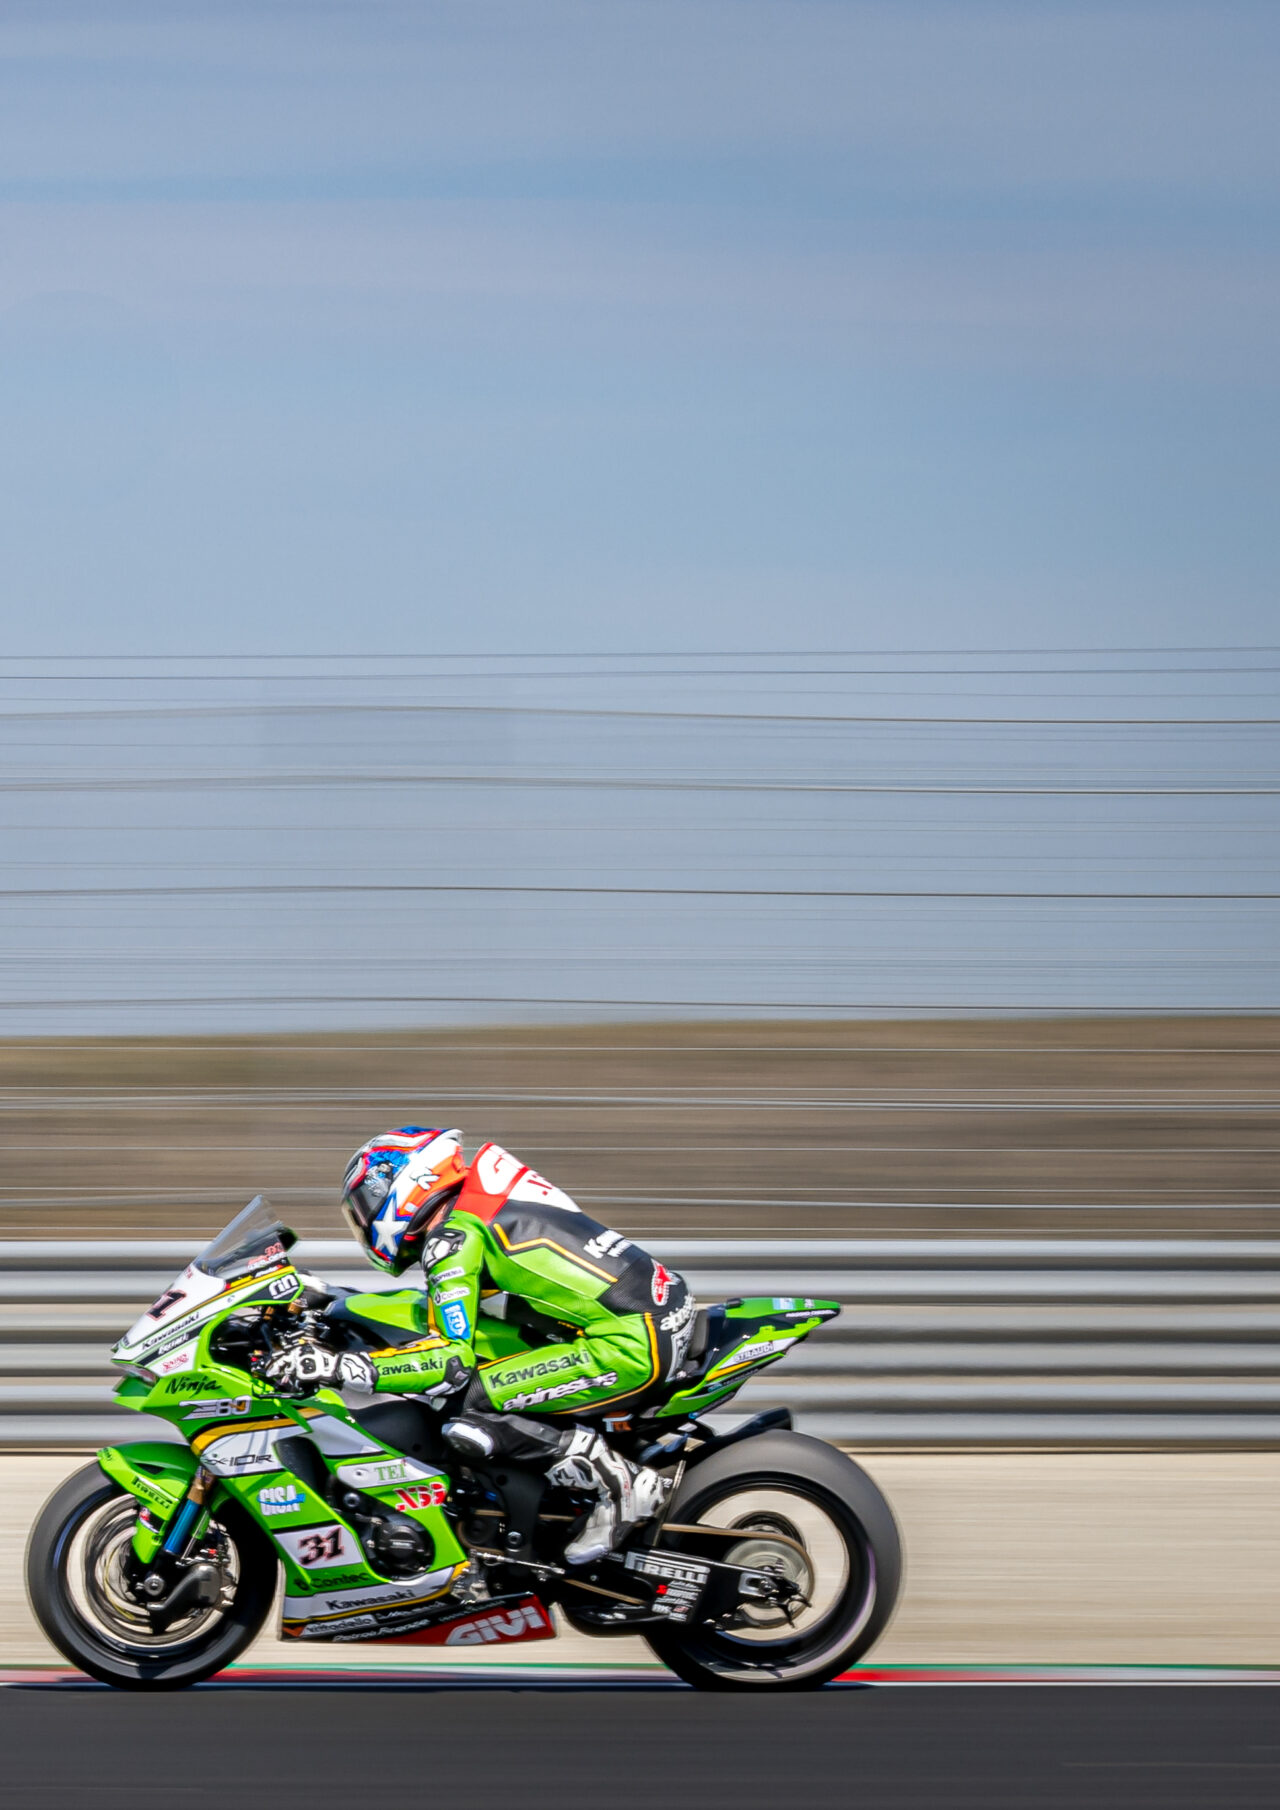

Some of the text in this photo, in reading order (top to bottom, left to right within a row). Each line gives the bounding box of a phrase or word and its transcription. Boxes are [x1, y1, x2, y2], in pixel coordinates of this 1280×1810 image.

[488, 1349, 590, 1389] Kawasaki
[165, 1376, 222, 1399] Ninja
[298, 1527, 345, 1566] 31
[624, 1551, 711, 1585] PIRELLI
[325, 1589, 417, 1611] Kawasaki
[445, 1606, 546, 1645] GIVI
